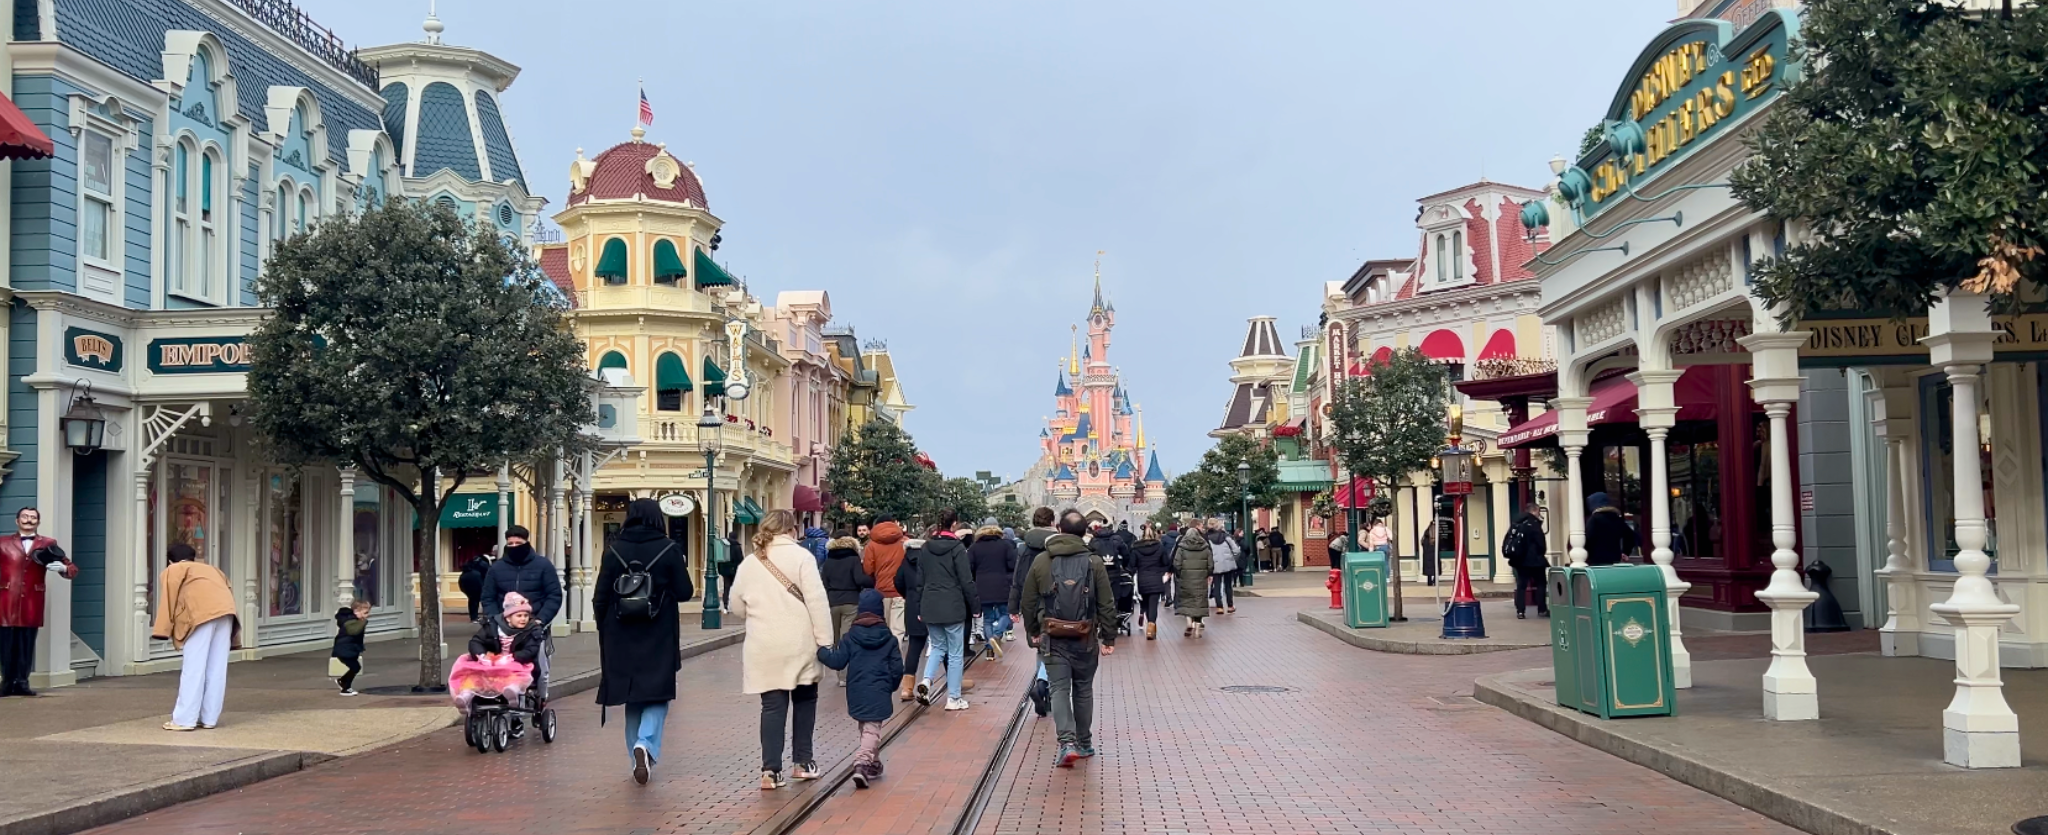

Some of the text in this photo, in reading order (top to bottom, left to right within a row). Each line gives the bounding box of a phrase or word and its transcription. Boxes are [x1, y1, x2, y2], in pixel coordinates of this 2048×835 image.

[1631, 41, 1708, 121] DISNEY
[81, 338, 107, 356] BELTS
[1332, 328, 1342, 369] MARKET
[1810, 323, 1882, 350] DISNEY
